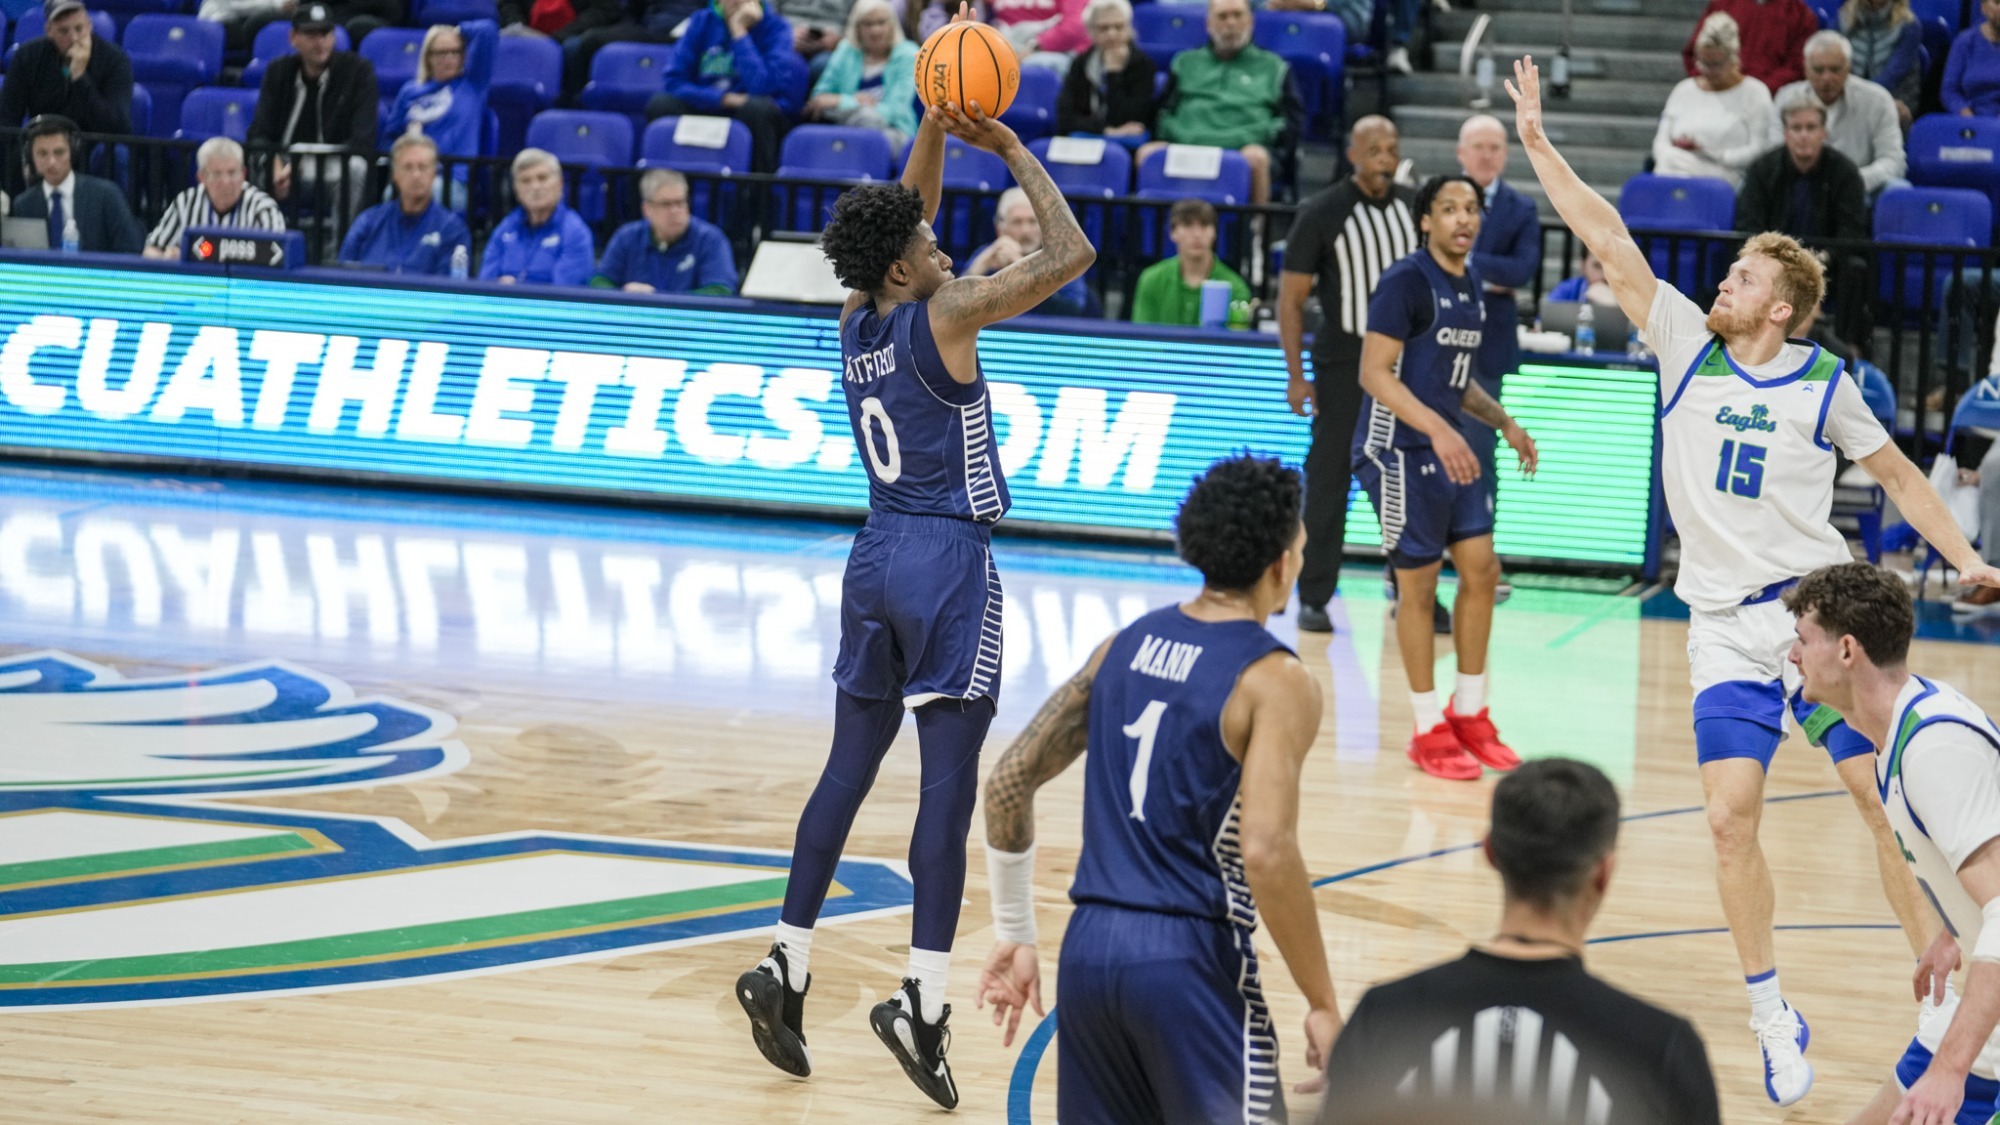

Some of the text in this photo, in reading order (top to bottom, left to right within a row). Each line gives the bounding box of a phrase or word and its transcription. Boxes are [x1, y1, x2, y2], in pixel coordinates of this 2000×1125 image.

[219, 238, 256, 262] poss
[1448, 351, 1471, 389] 11
[0, 314, 1178, 492] CUATHLETICS.OM
[1715, 404, 1777, 433] Eagles
[860, 396, 902, 484] 0
[1715, 438, 1768, 500] 15
[1129, 633, 1204, 684] MANN
[1122, 699, 1169, 823] 1
